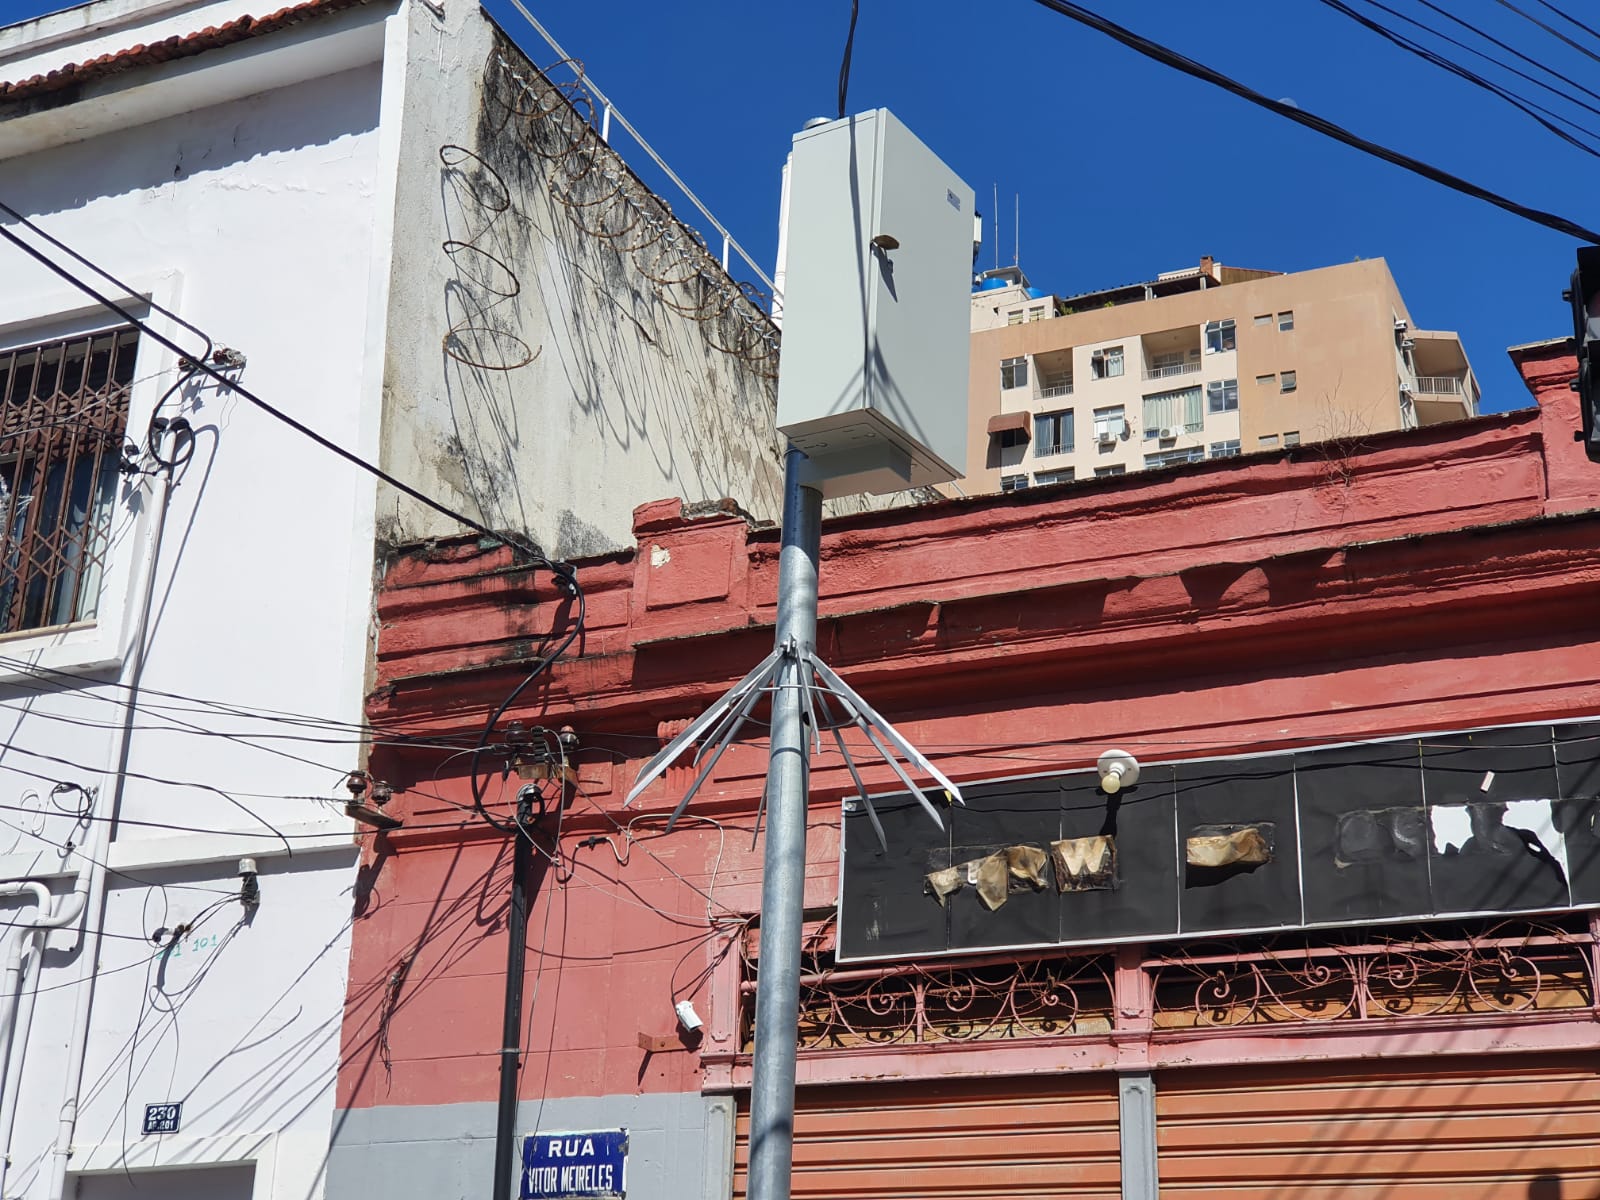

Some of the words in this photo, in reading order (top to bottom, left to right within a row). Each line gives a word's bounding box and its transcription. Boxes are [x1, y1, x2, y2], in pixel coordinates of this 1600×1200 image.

[192, 934, 217, 952] 101
[148, 1106, 176, 1121] 230
[548, 1138, 595, 1158] RUA
[528, 1166, 558, 1194] VITOR
[561, 1164, 613, 1193] MEIRELES
